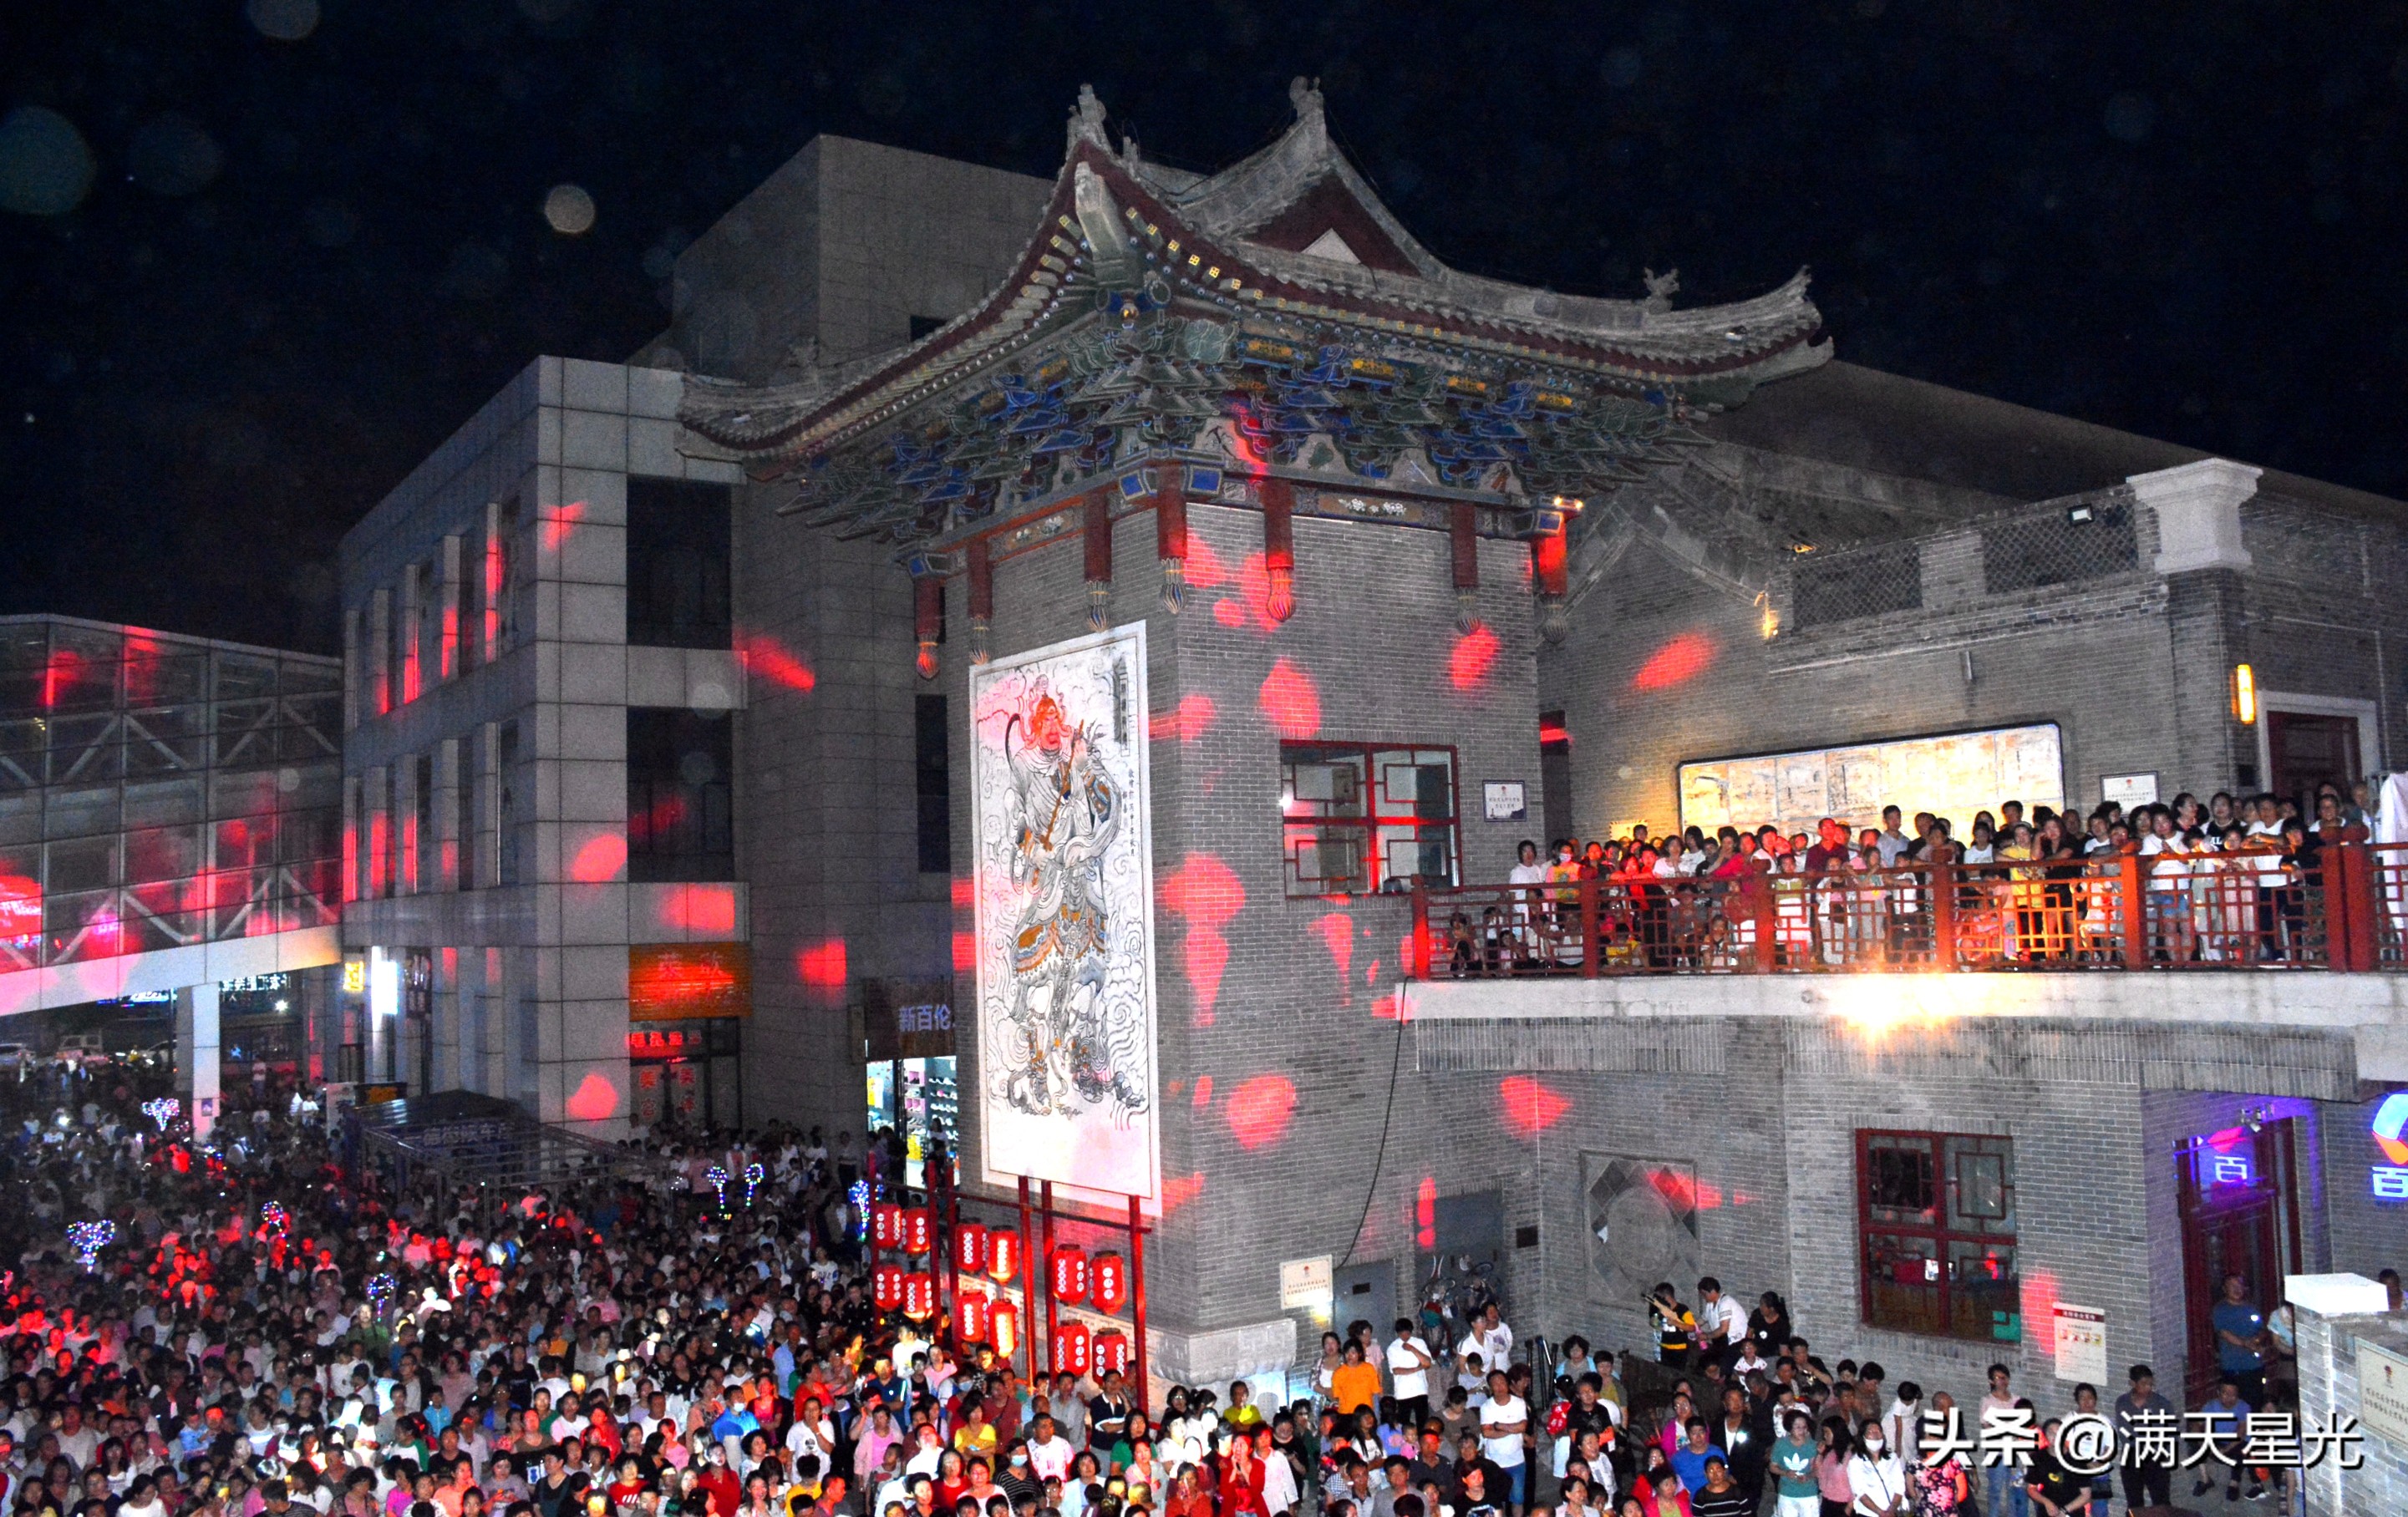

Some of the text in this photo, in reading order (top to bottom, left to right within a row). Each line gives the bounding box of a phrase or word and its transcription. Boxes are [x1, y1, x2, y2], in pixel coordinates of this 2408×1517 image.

[898, 1003, 951, 1032] 新百伦
[2371, 1166, 2408, 1198] 百
